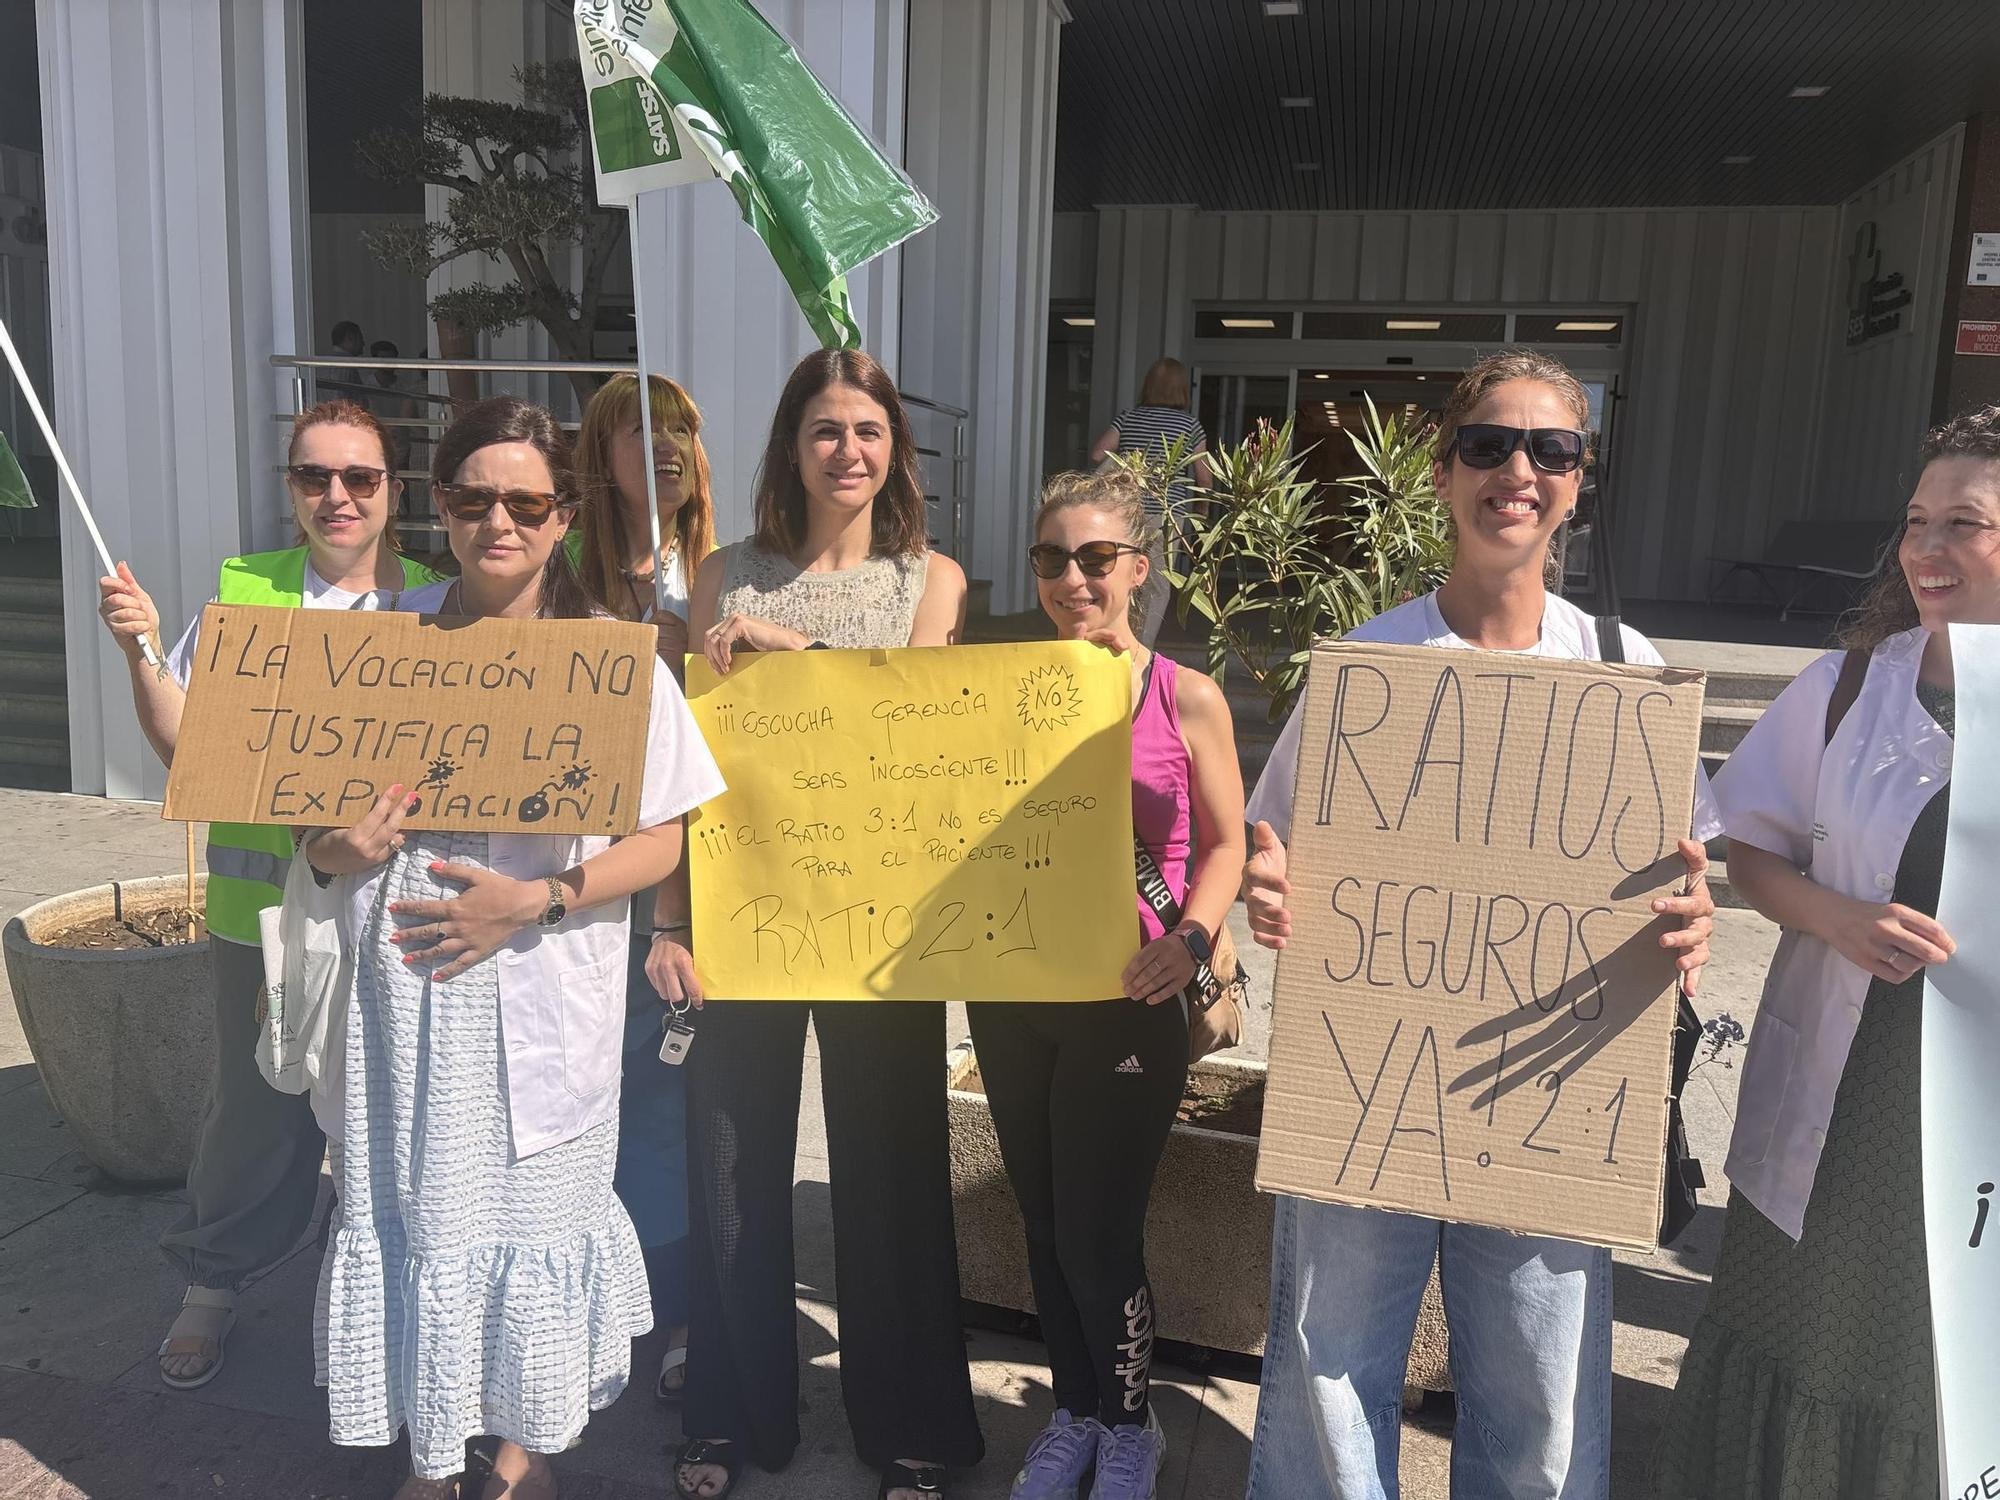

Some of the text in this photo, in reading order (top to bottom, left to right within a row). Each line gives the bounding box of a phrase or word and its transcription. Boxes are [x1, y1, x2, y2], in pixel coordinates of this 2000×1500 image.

[635, 82, 671, 158] SATSE
[323, 632, 537, 690] VOCACIÓN
[568, 649, 637, 696] NO
[1036, 681, 1061, 710] NO
[246, 708, 583, 761] JUSTIFICA LA
[792, 770, 847, 790] SEAS
[1315, 663, 1673, 875] RATIOS
[864, 801, 917, 833] 3:1
[939, 810, 962, 830] NO
[979, 808, 1003, 825] ES
[1023, 795, 1097, 825] SEGURO
[791, 855, 853, 878] PARA
[880, 851, 907, 868] EL
[918, 887, 1037, 961] 2:1
[1324, 876, 1614, 1022] SEGUROS
[1114, 1065, 1144, 1073] adidas
[1321, 1010, 1629, 1202] YA! 2:1
[1115, 1285, 1152, 1412] adidas
